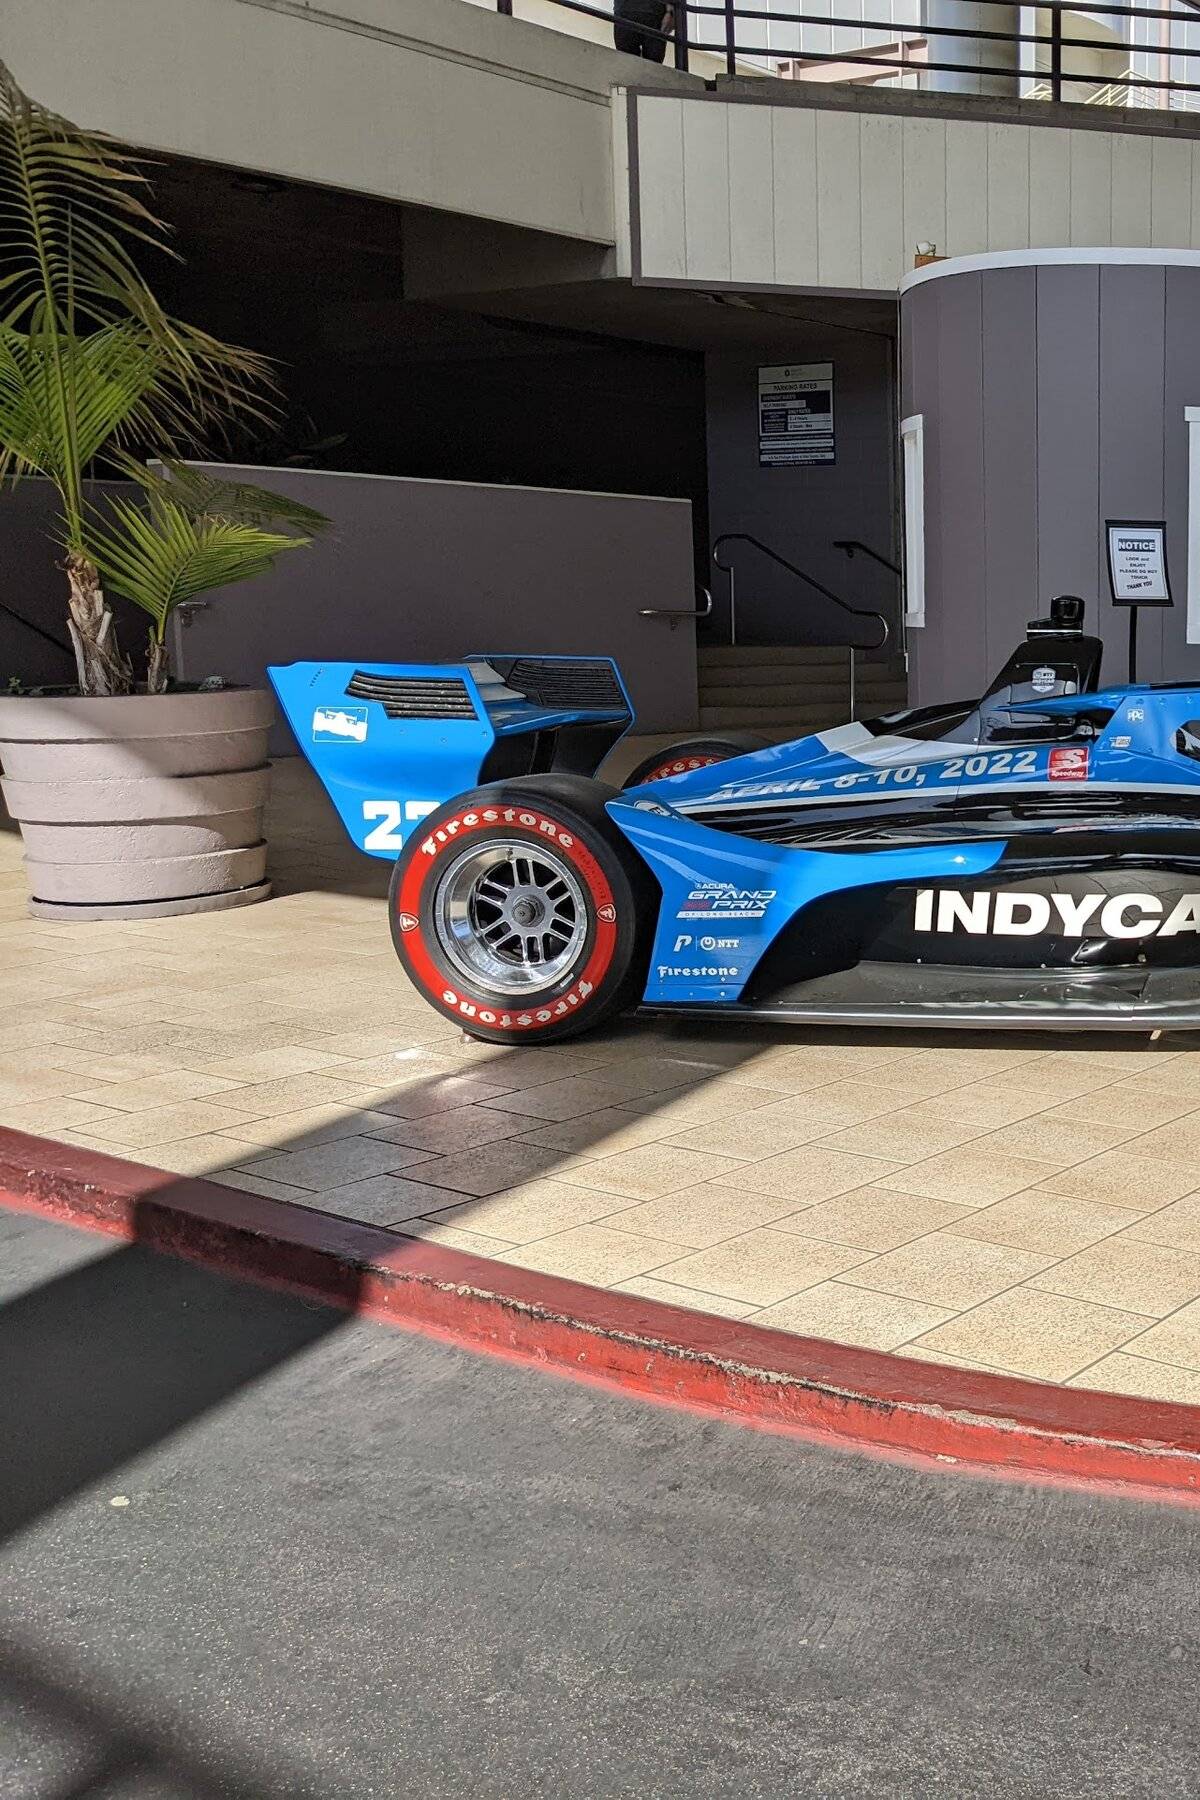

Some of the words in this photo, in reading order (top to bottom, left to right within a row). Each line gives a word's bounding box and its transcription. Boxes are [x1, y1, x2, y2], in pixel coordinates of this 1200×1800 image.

[1118, 541, 1156, 551] NOTICE
[705, 778, 821, 801] APRIL
[833, 766, 926, 789] 8-10,
[939, 751, 1038, 779] 2022
[1051, 769, 1085, 779] Speedway
[421, 808, 573, 856] Firestone
[687, 890, 777, 900] GRAND
[711, 900, 770, 909] PRIX
[717, 939, 740, 948] NTT
[657, 965, 739, 979] Firestone
[442, 979, 594, 1028] Firestone
